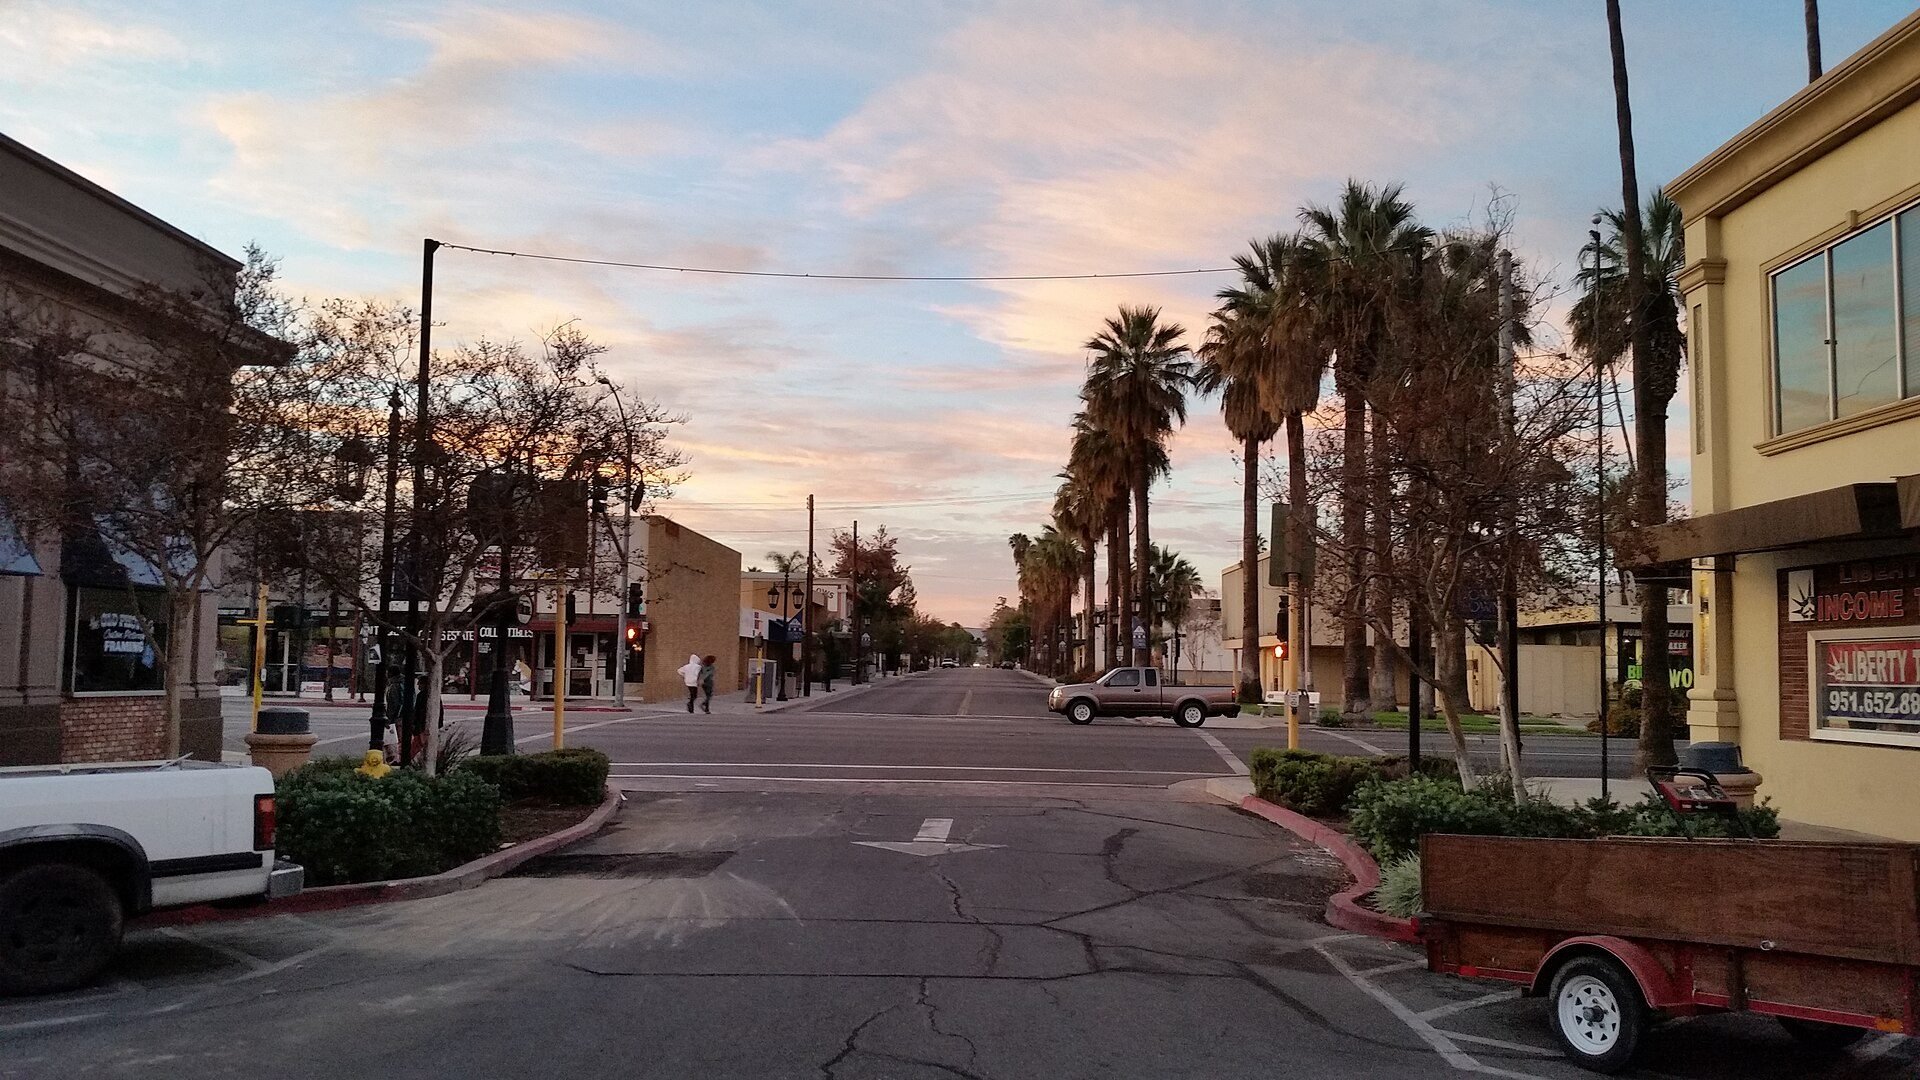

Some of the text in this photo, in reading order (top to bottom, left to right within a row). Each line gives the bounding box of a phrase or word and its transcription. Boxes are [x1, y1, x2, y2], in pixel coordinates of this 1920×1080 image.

[1818, 589, 1904, 621] INCOME
[479, 627, 533, 638] COLLTIBLES
[1844, 650, 1907, 682] LIBERTY
[1829, 690, 1920, 715] 951.652.88
